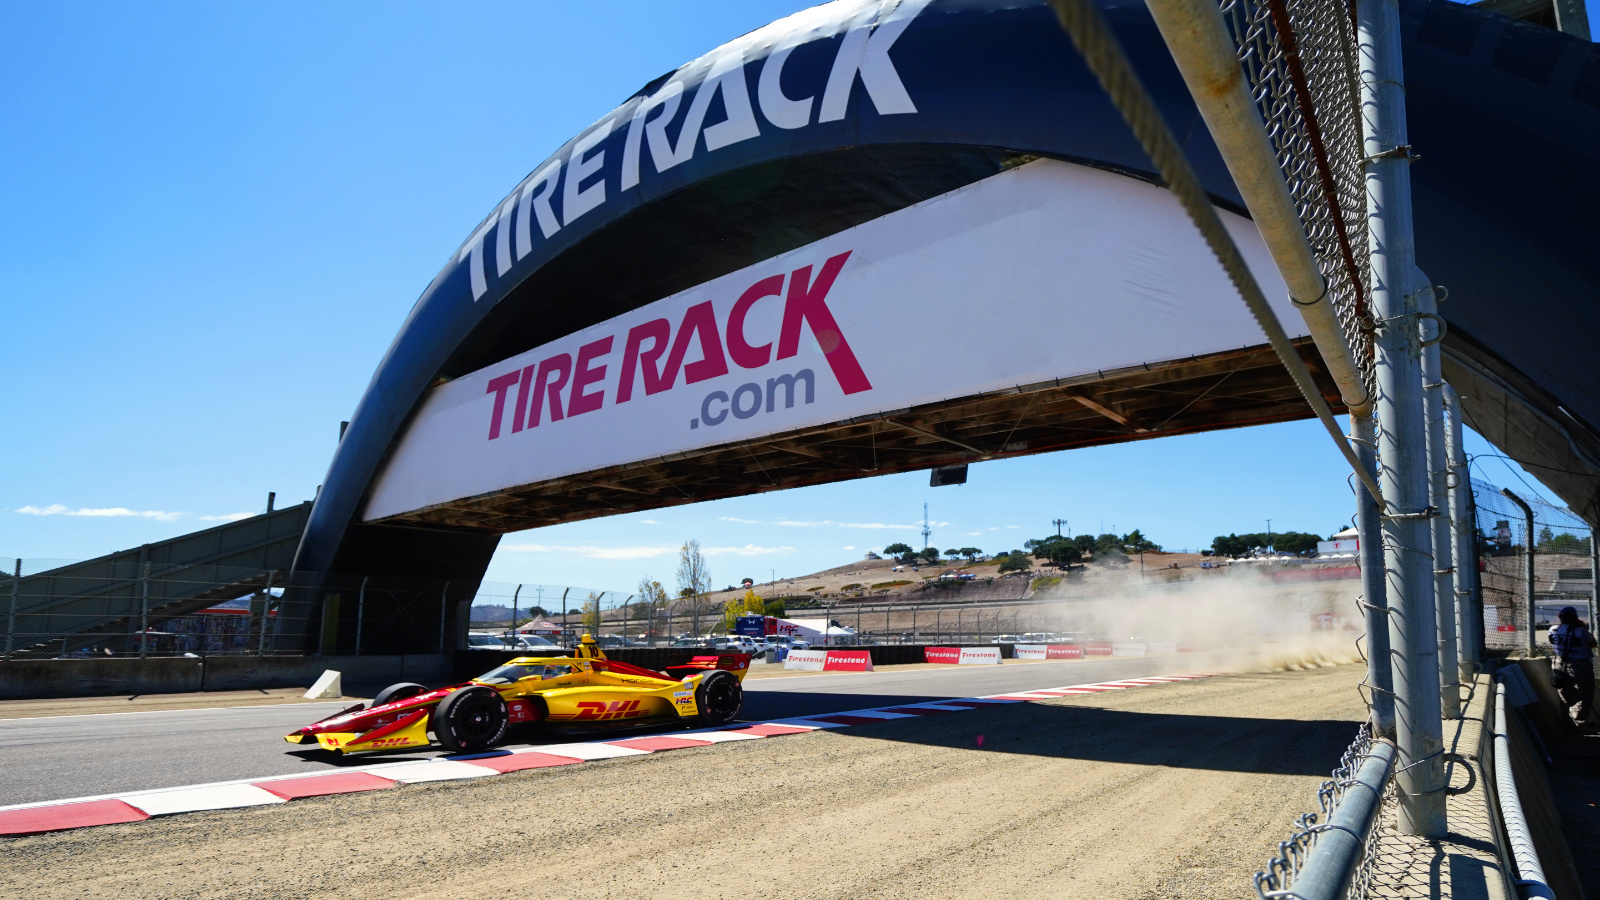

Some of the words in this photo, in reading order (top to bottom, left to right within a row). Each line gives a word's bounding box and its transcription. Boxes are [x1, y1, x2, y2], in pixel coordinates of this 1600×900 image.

[459, 118, 617, 302] TIRE
[621, 0, 933, 192] RACK
[486, 335, 614, 441] TIRE
[615, 249, 873, 405] RACK
[690, 368, 815, 430] .com
[588, 646, 599, 658] 10
[788, 655, 824, 663] Firestone
[827, 656, 866, 664] Firestone
[574, 699, 642, 720] DHL
[370, 736, 411, 748] DHL
